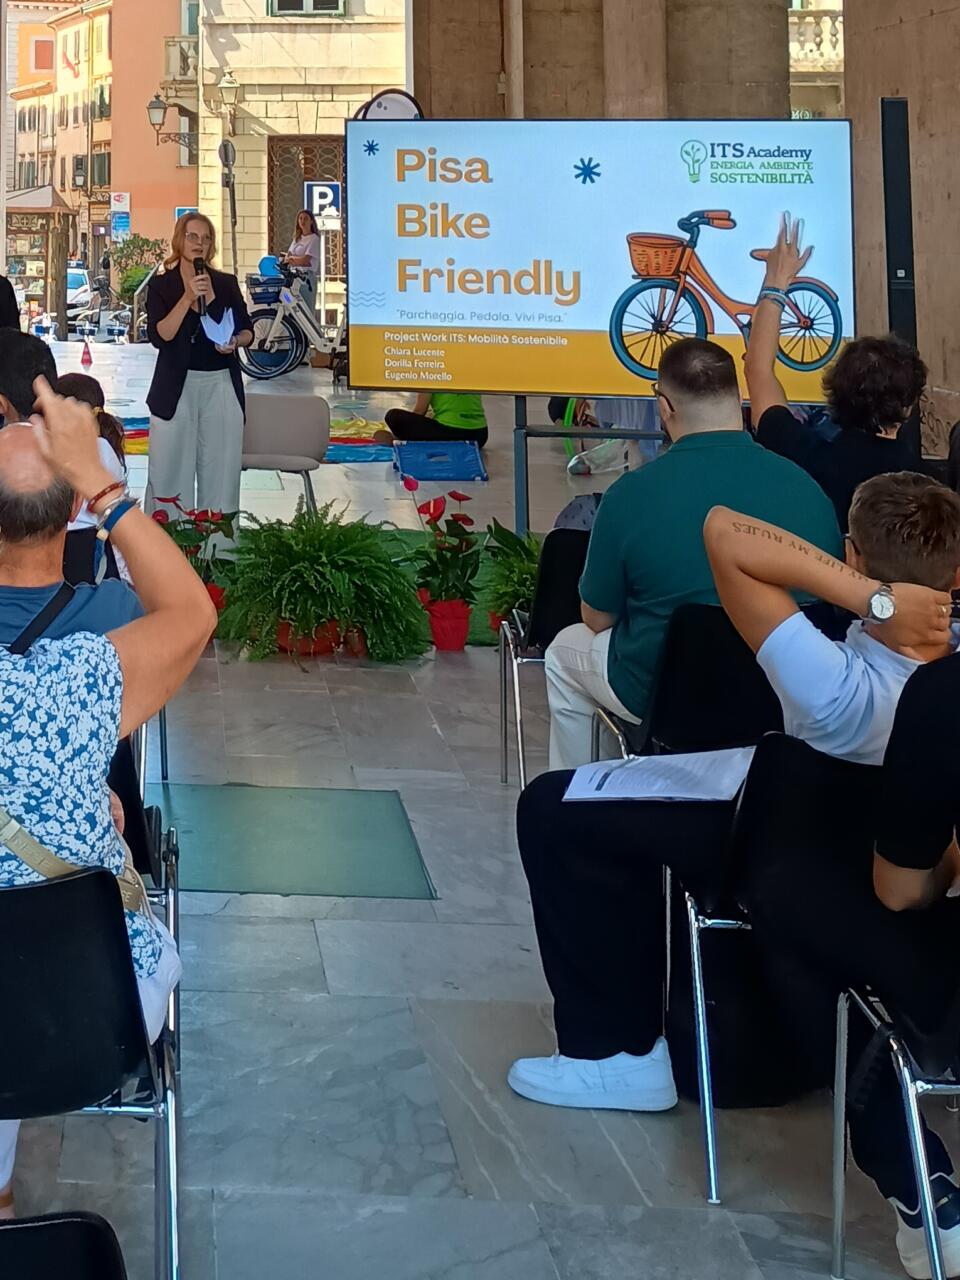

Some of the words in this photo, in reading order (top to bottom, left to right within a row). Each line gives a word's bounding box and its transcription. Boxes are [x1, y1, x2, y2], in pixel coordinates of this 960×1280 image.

[710, 142, 744, 158] ITS
[746, 146, 812, 161] Academy
[395, 147, 494, 184] Pisa
[710, 161, 754, 170] ENERGIA
[759, 161, 814, 170] AMBIENTE
[710, 170, 814, 184] SOSTENIBILITÀ
[312, 186, 334, 214] P
[396, 202, 491, 239] Bike
[397, 257, 581, 306] Friendly
[470, 311, 512, 322] Pedala.
[515, 312, 535, 322] Vivi
[384, 331, 419, 343] Project
[421, 332, 447, 343] Work
[449, 333, 466, 343] ITS:
[468, 333, 509, 344] Mobilità
[511, 334, 568, 346] Sostenibile
[384, 346, 411, 356] Chiara
[413, 347, 445, 357] Lucente
[385, 371, 418, 382] Eugenio
[789, 539, 809, 556] MY
